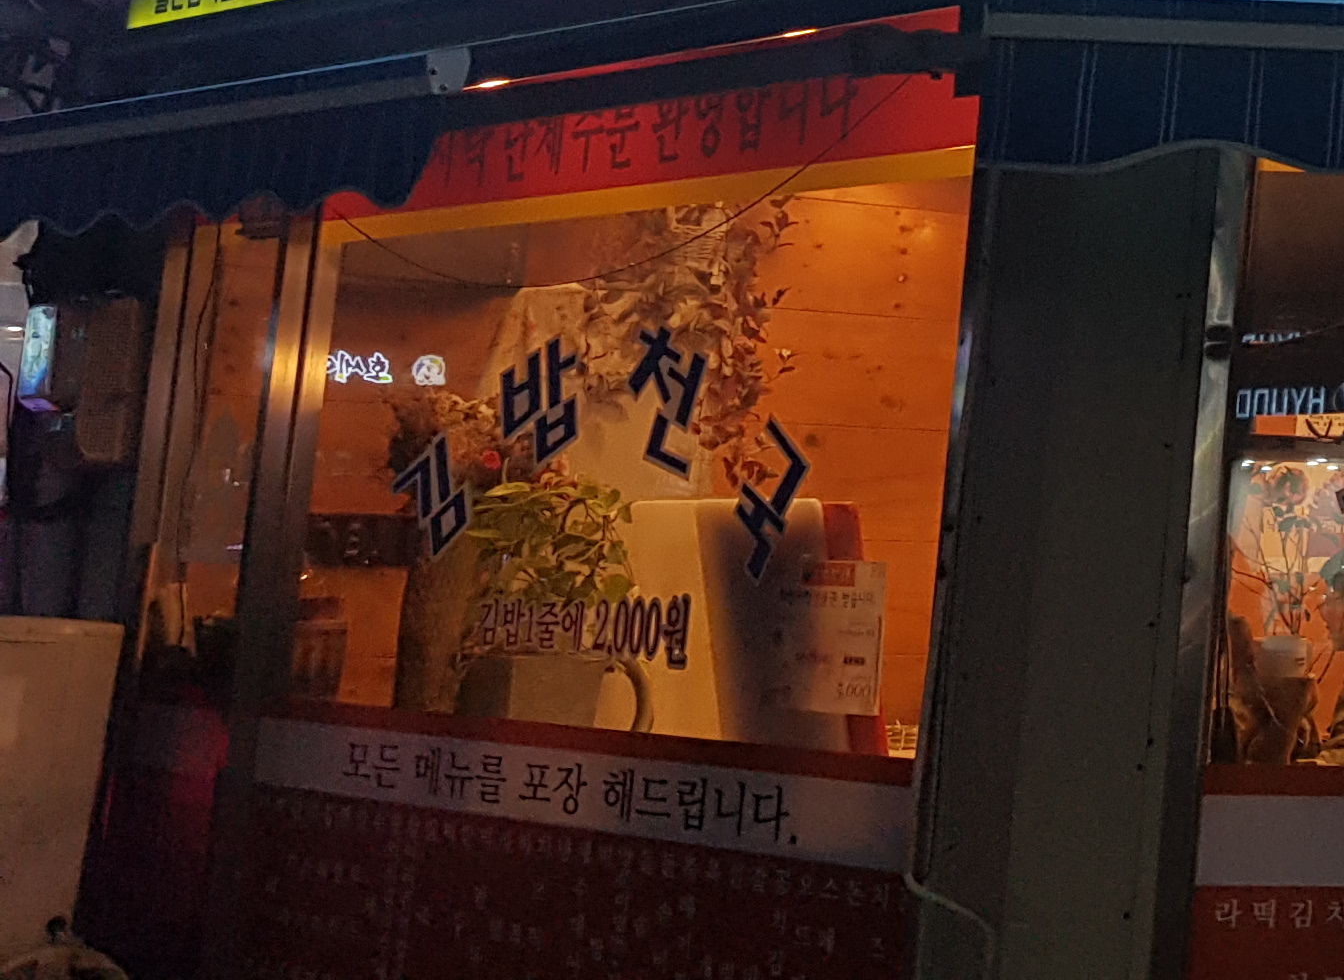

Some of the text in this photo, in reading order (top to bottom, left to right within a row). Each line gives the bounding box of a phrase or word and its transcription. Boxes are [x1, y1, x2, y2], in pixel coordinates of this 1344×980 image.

[392, 324, 811, 583] 김밥천국
[475, 592, 694, 673] 김밥1줄에 2,000원
[343, 741, 800, 847] 모든 메뉴를 포장 해드립니다.
